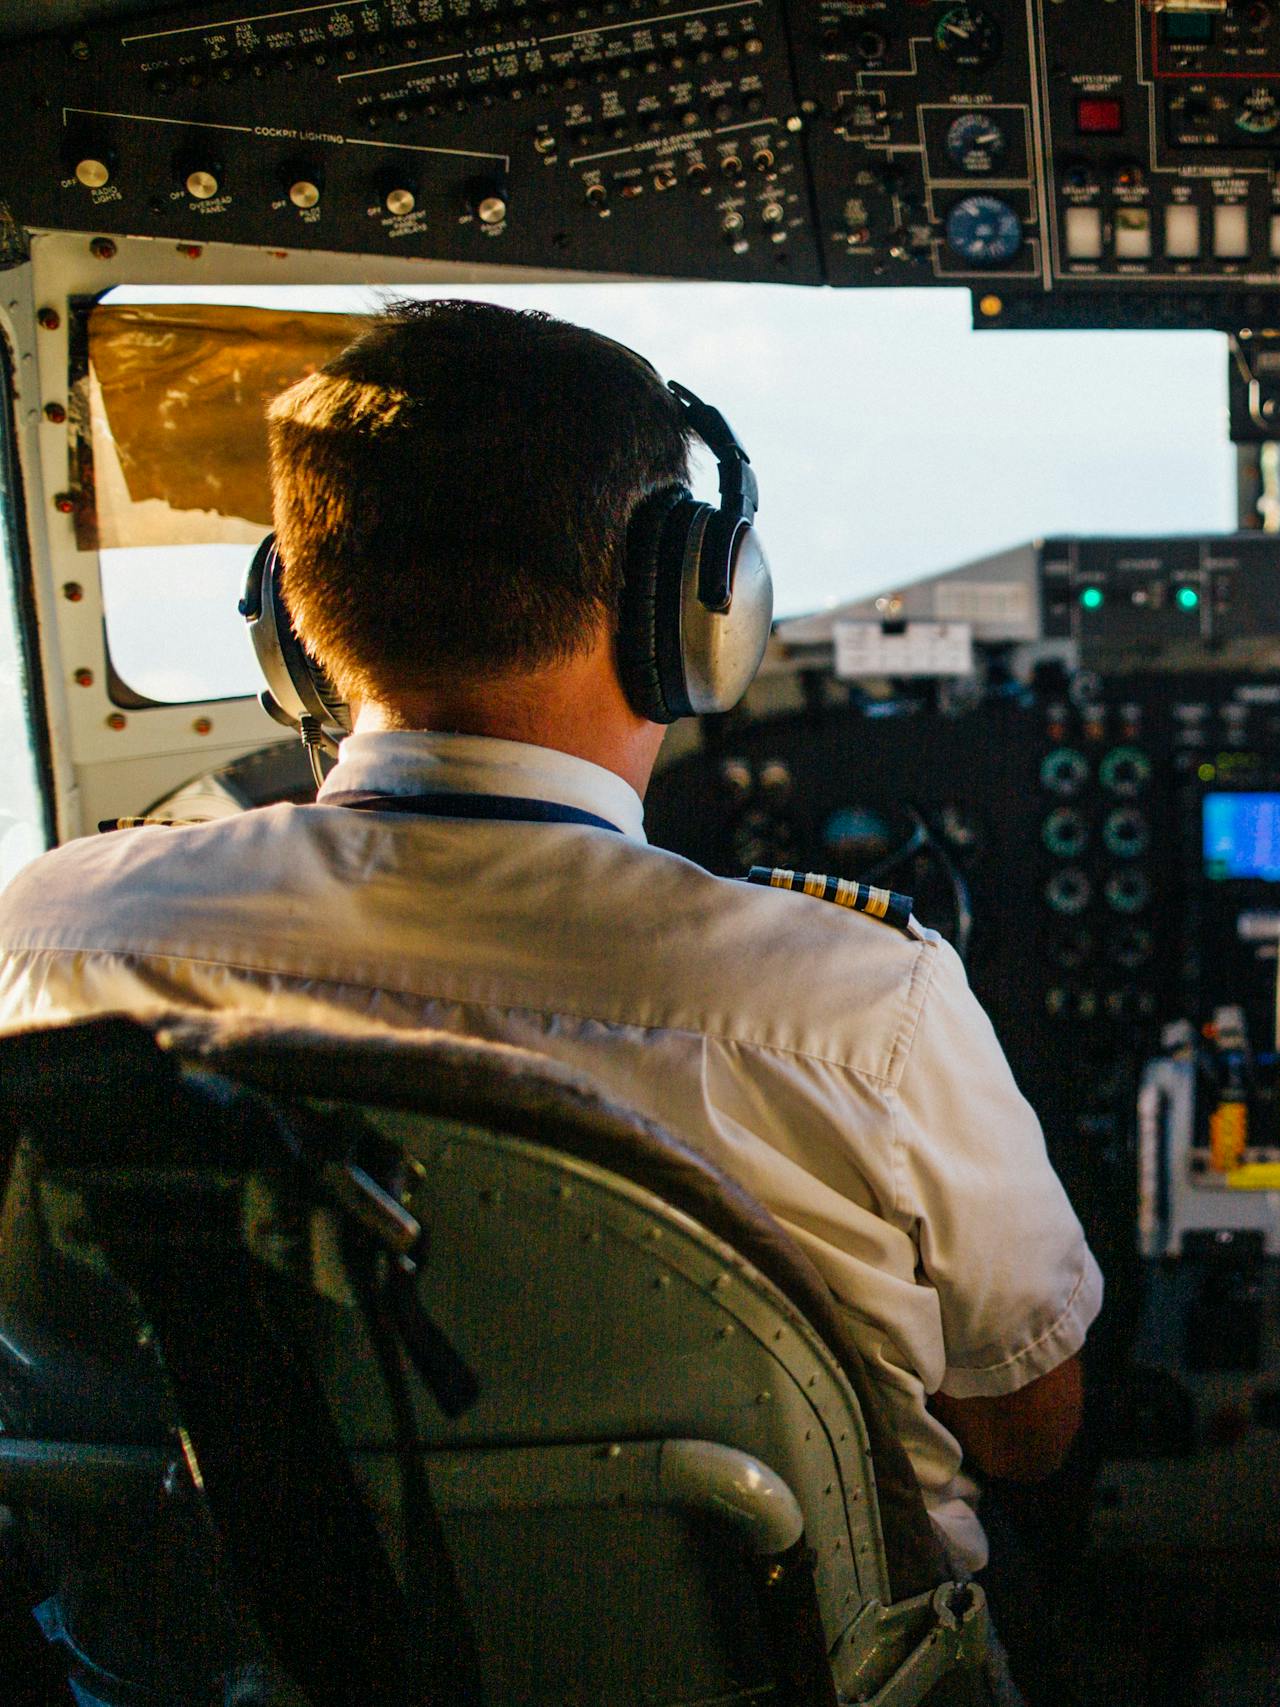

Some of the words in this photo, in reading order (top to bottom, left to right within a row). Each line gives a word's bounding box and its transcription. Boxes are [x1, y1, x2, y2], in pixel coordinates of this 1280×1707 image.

[203, 35, 227, 46] TURN
[255, 126, 297, 140] COCKPIT
[299, 127, 344, 144] LIGHTING
[60, 177, 77, 188] OFF
[91, 185, 117, 196] RADIO
[169, 191, 185, 201] OFF
[93, 192, 123, 204] LIGHTS
[189, 195, 233, 211] OVERHEAD
[201, 205, 227, 215] PANEL
